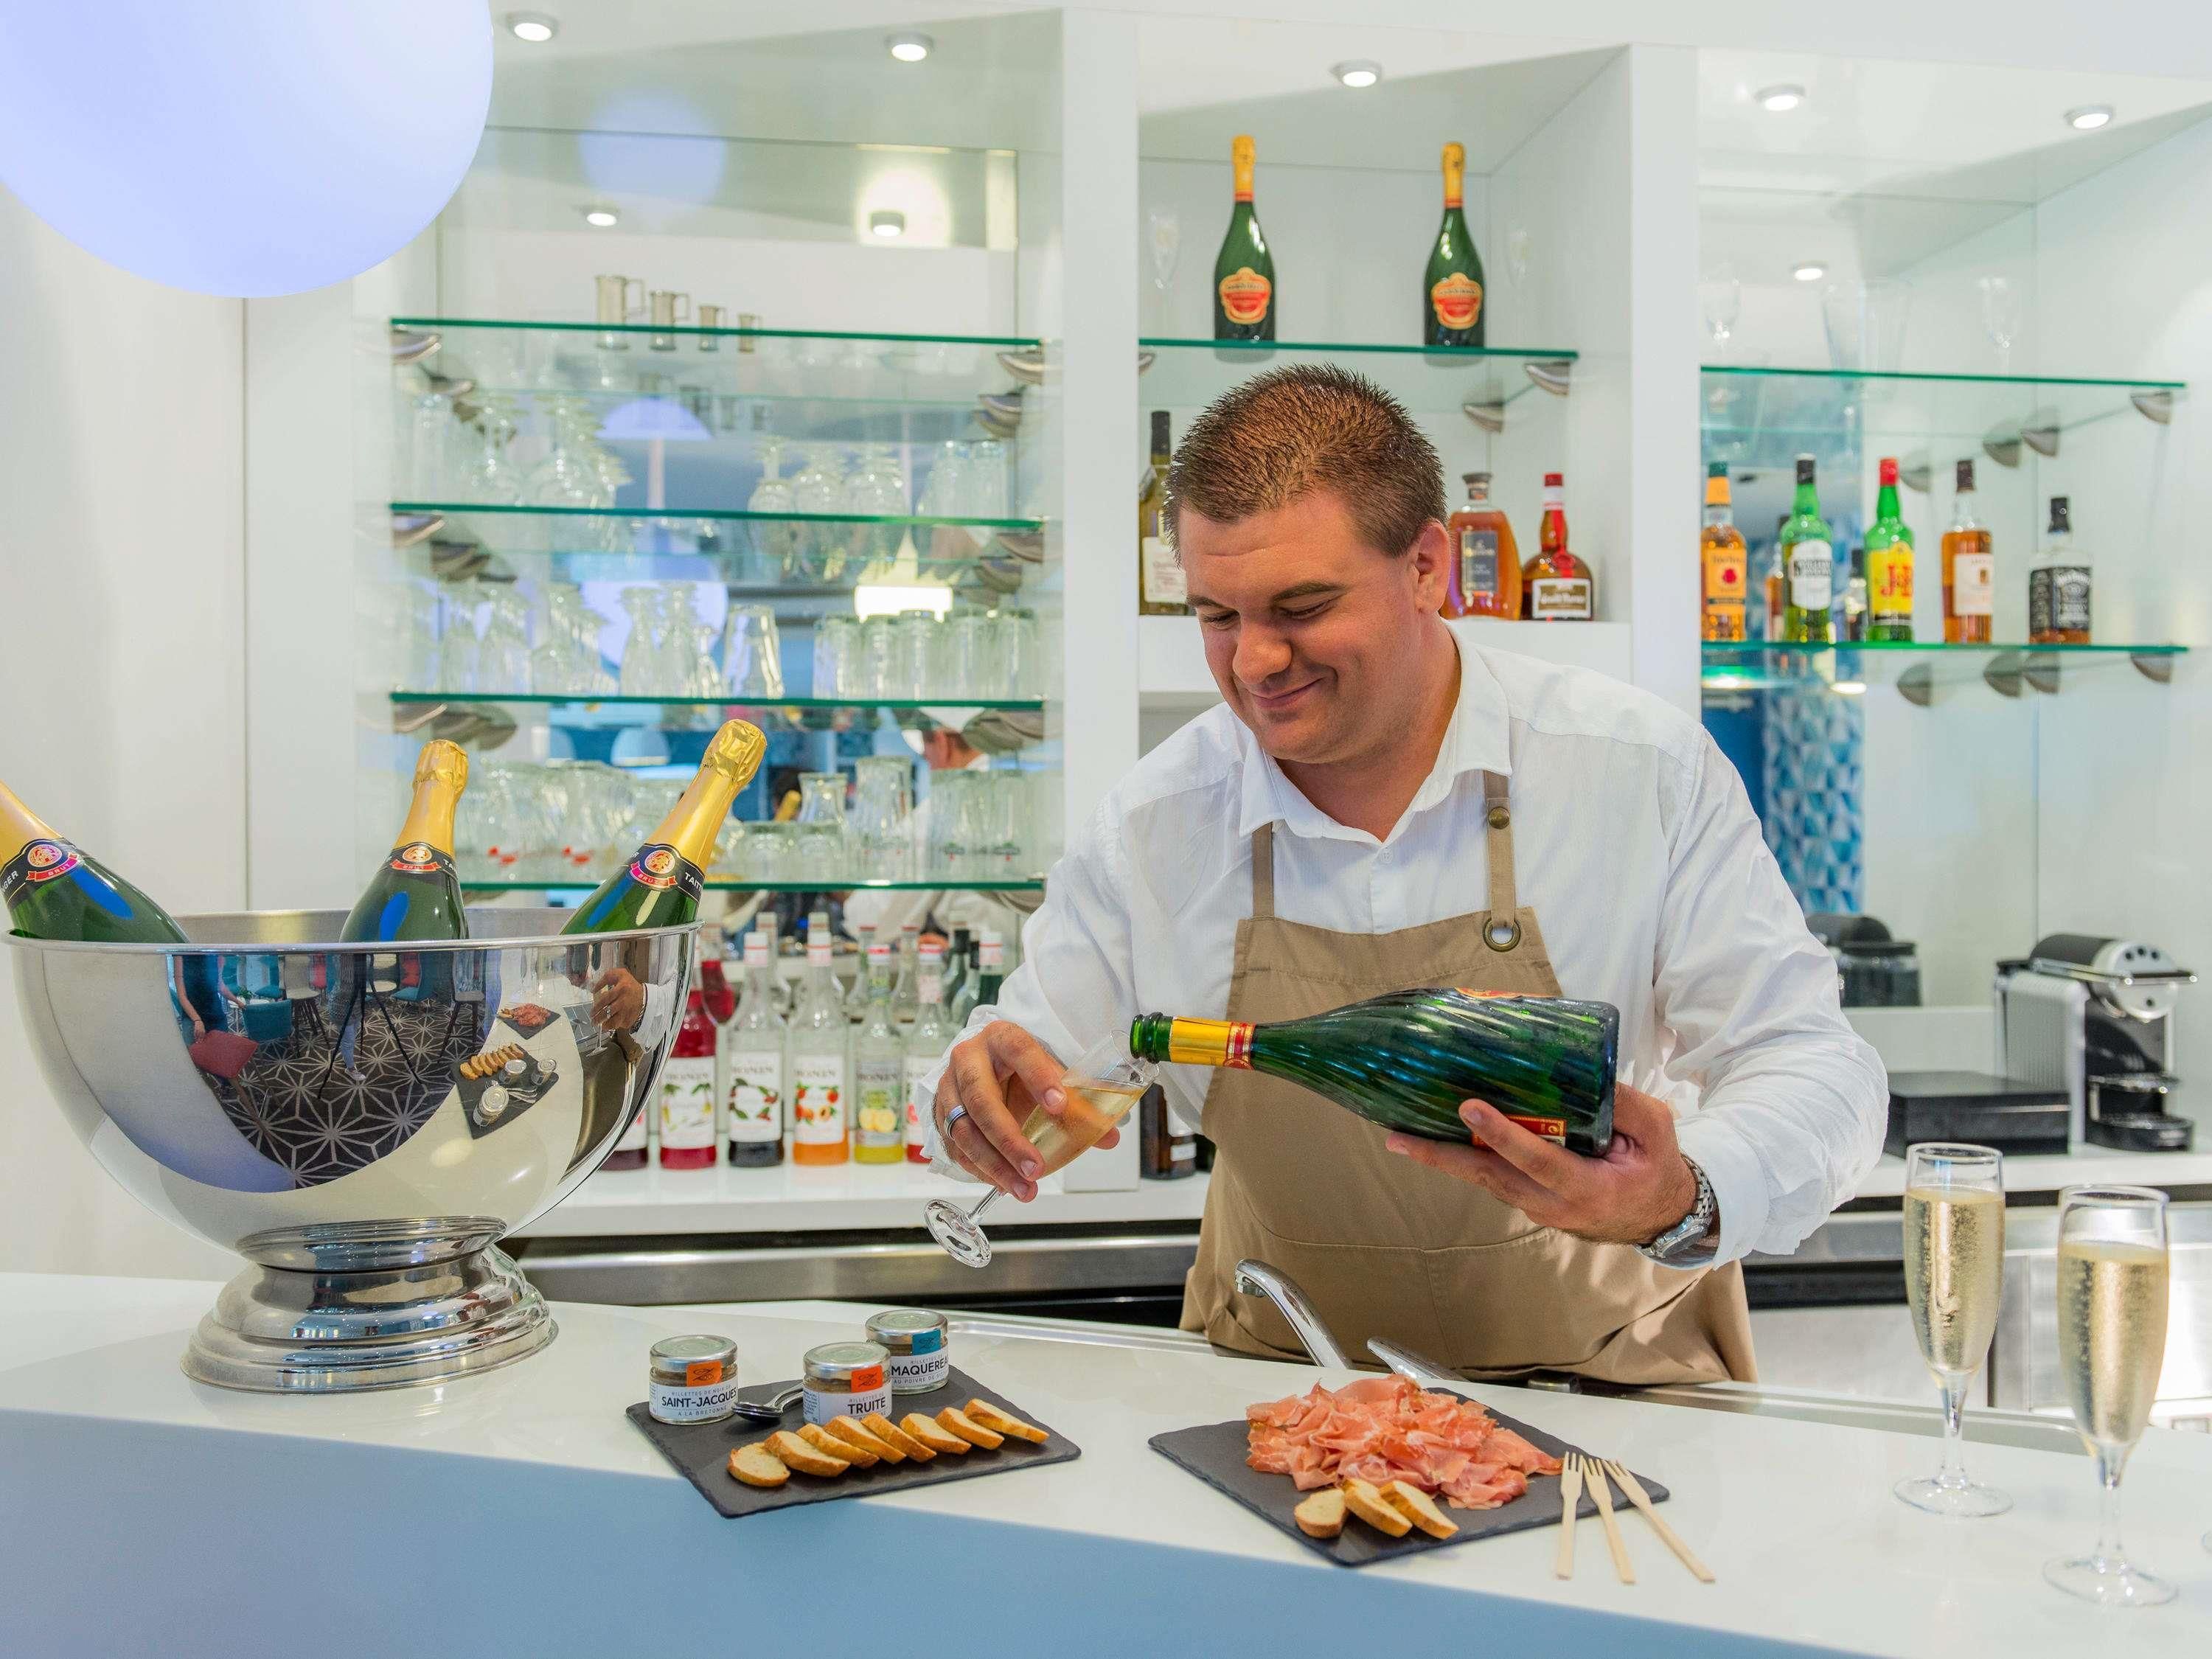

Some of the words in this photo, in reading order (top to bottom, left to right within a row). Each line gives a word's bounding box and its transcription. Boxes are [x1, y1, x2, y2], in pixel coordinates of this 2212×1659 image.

[48, 863, 71, 876] BRUT
[661, 1386, 737, 1408] SAINT-JACQUES
[695, 1406, 727, 1416] BRETONNE
[848, 1397, 886, 1415] TRUITE
